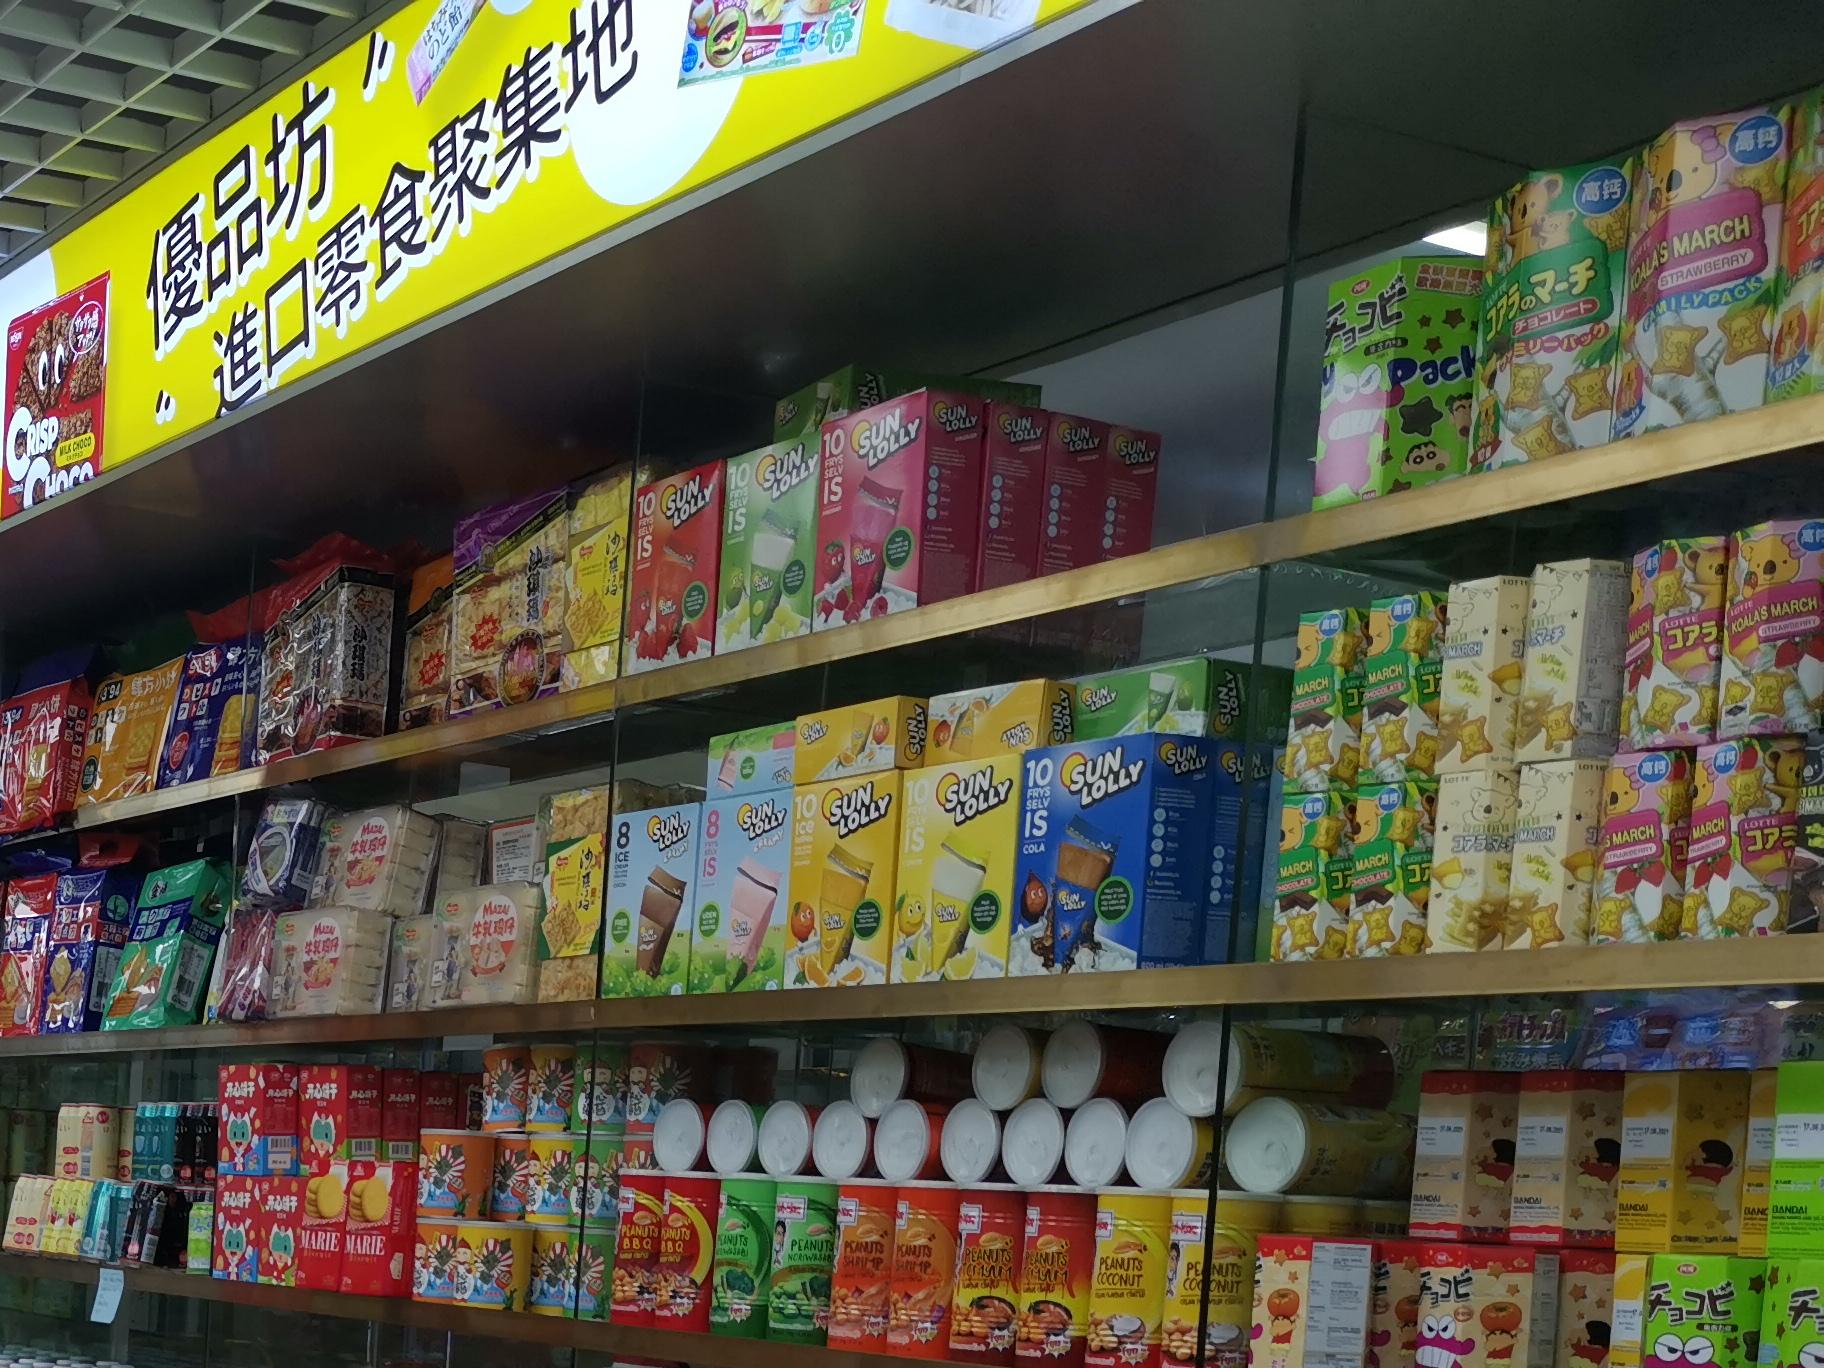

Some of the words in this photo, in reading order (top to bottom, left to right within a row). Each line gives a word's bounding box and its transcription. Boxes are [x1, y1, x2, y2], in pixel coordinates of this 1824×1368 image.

[1734, 125, 1778, 152] 高钙
[1580, 178, 1623, 202] 高钙
[146, 80, 330, 350] 優品坊
[212, 0, 640, 418] 進口零食聚集地
[1673, 214, 1750, 259] MARCH
[1660, 251, 1749, 288] STRAWBERRY
[1485, 259, 1597, 341] コアラのマーチ
[1514, 300, 1594, 333] チョコレート
[939, 405, 967, 422] SUN
[945, 415, 978, 432] LOLLY
[824, 430, 845, 455] 10
[856, 408, 901, 454] SUN
[6, 407, 59, 481] CRISP
[59, 443, 73, 457] MILK
[73, 435, 91, 451] CHOCO
[866, 419, 921, 468] LOLLY
[823, 479, 842, 504] IS
[637, 495, 655, 517] 10
[672, 483, 712, 526] LOLLY
[1771, 595, 1819, 618] MARCH
[1664, 615, 1699, 628] LOTTE
[1760, 617, 1818, 637] STRAWBERRY
[1295, 677, 1329, 696] MARCH
[1368, 664, 1404, 686] MARCH
[1026, 757, 1053, 787] 10
[1069, 749, 1122, 792] SUN
[1640, 759, 1666, 778] 高钙
[1079, 761, 1144, 808] LOLLY
[951, 778, 1013, 824] LOLLY
[616, 821, 630, 849] 8
[659, 819, 690, 851] LOLLY
[705, 810, 720, 839] 8
[1025, 810, 1048, 839] IS
[1519, 825, 1555, 842] MARCH
[1617, 823, 1655, 846] MARCH
[614, 851, 630, 863] ICE
[1022, 842, 1046, 855] COLA
[1618, 1203, 1649, 1212] BANDAI
[1772, 1205, 1808, 1215] BANDAI
[301, 1227, 340, 1252] MARIE
[345, 1231, 385, 1256] MARIE
[790, 1237, 834, 1254] PEANUTS
[843, 1238, 884, 1257] PEANUTS
[843, 1254, 883, 1271] SHRIMP
[964, 1247, 1013, 1267] PEANUTS
[1098, 1254, 1144, 1273] PEANUTS
[1096, 1271, 1143, 1288] COCONUT
